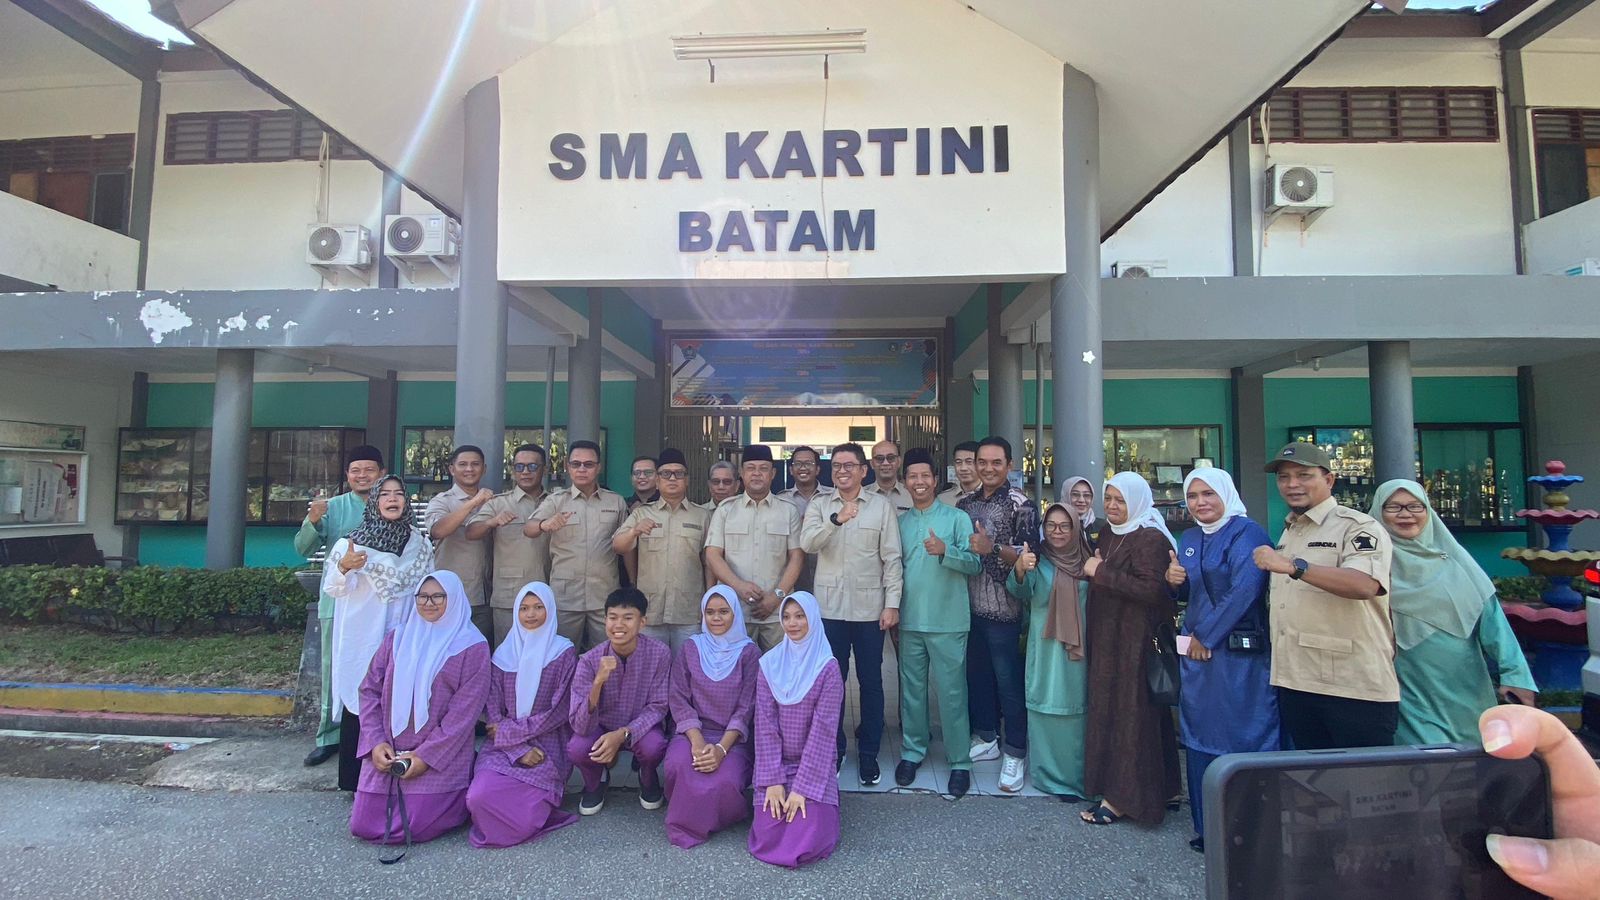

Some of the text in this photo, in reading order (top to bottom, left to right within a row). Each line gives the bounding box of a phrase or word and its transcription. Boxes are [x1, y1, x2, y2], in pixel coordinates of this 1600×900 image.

[548, 125, 1009, 181] SMA KARTINI
[678, 209, 875, 252] BATAM
